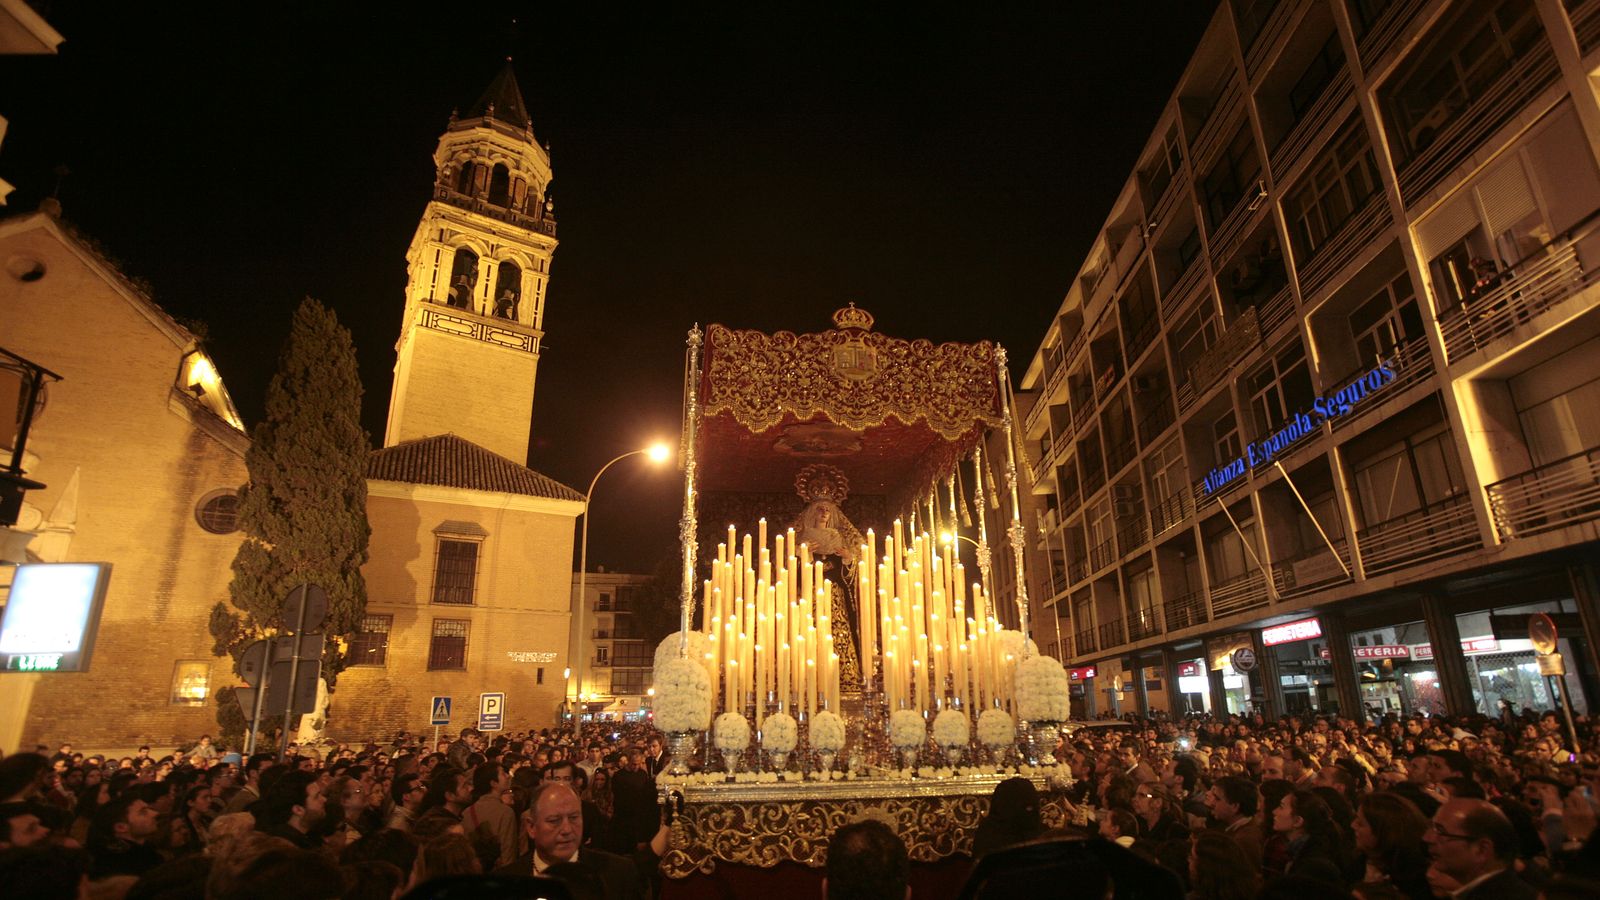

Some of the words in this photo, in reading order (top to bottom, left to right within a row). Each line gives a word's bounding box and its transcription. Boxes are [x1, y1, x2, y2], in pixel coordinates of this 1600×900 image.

[1203, 457, 1246, 496] Alianza
[1313, 360, 1397, 421] Seguros
[486, 699, 497, 712] P
